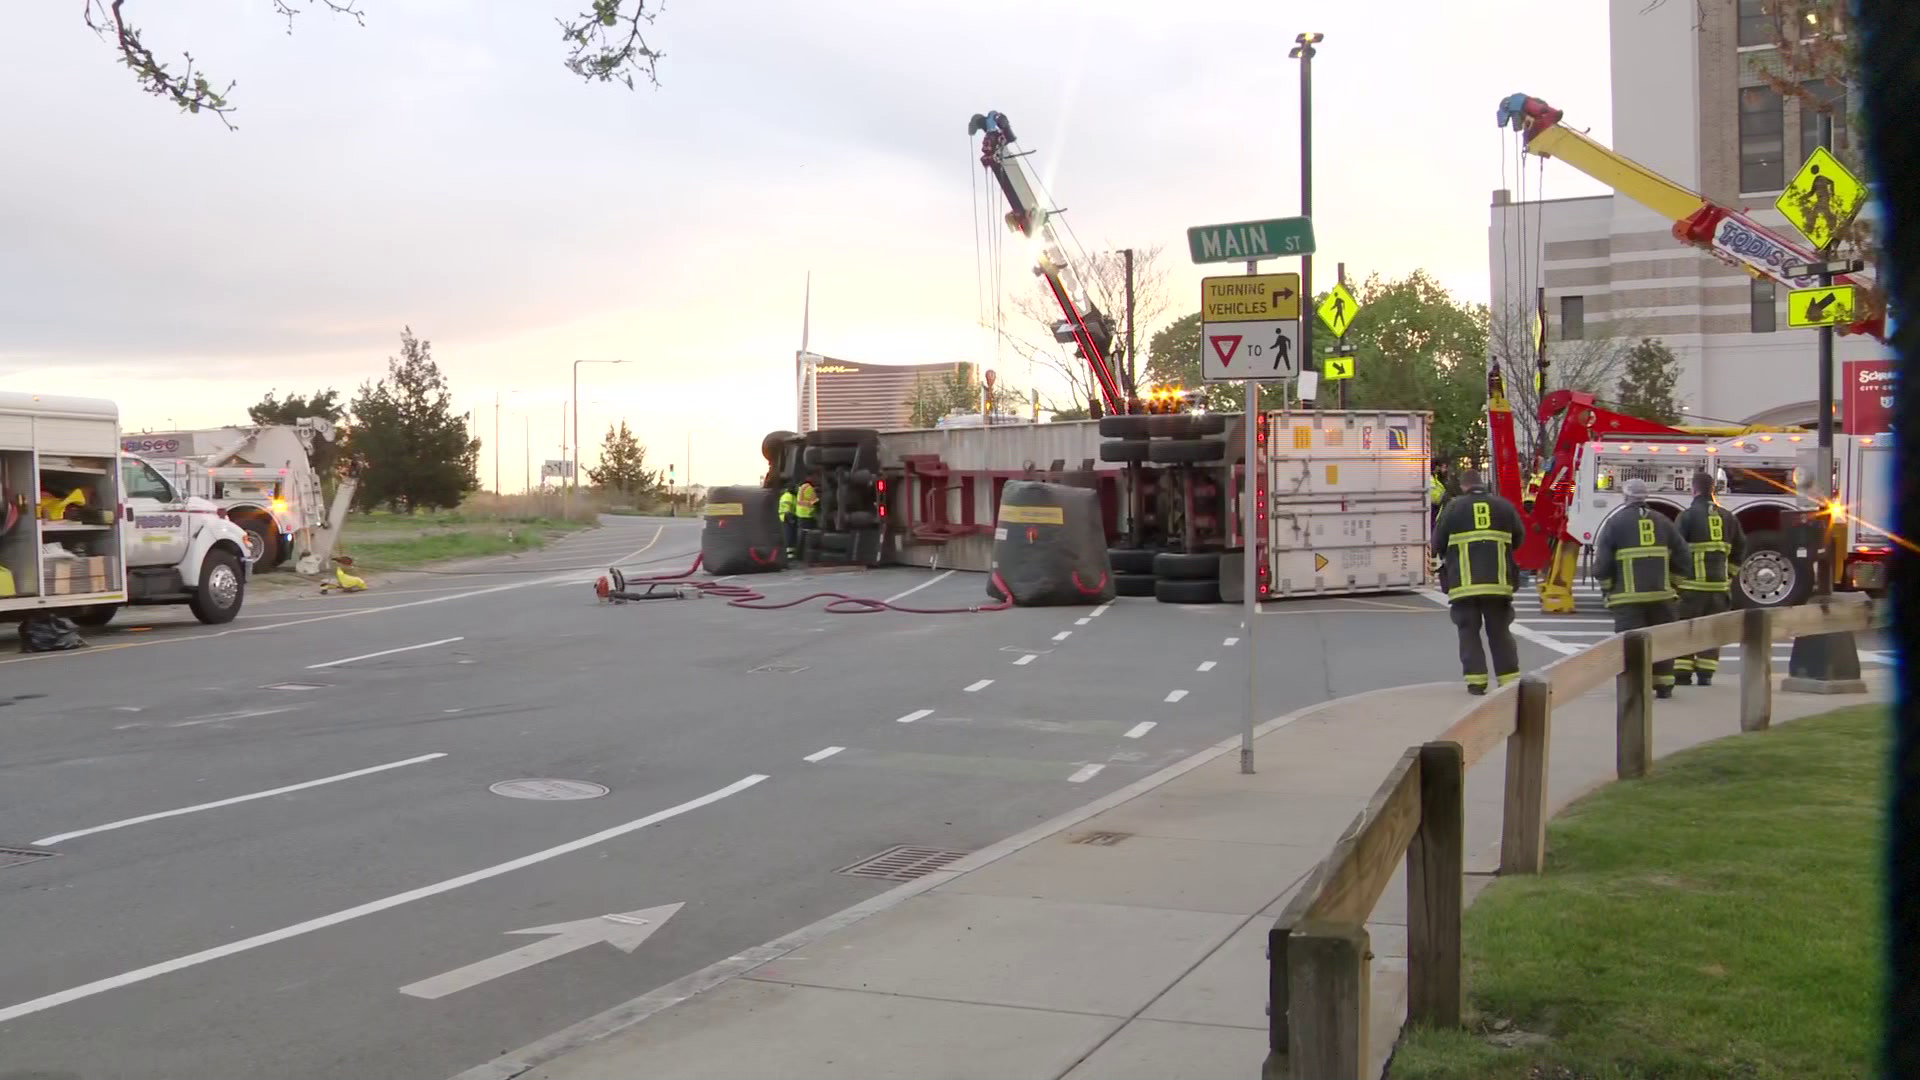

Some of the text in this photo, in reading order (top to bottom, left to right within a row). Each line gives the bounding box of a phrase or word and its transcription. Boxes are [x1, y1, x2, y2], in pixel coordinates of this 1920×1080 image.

[1201, 225, 1300, 258] MAIN ST
[1210, 283, 1265, 297] TURNING
[1209, 302, 1267, 315] VEHICLES
[1247, 344, 1263, 357] TO
